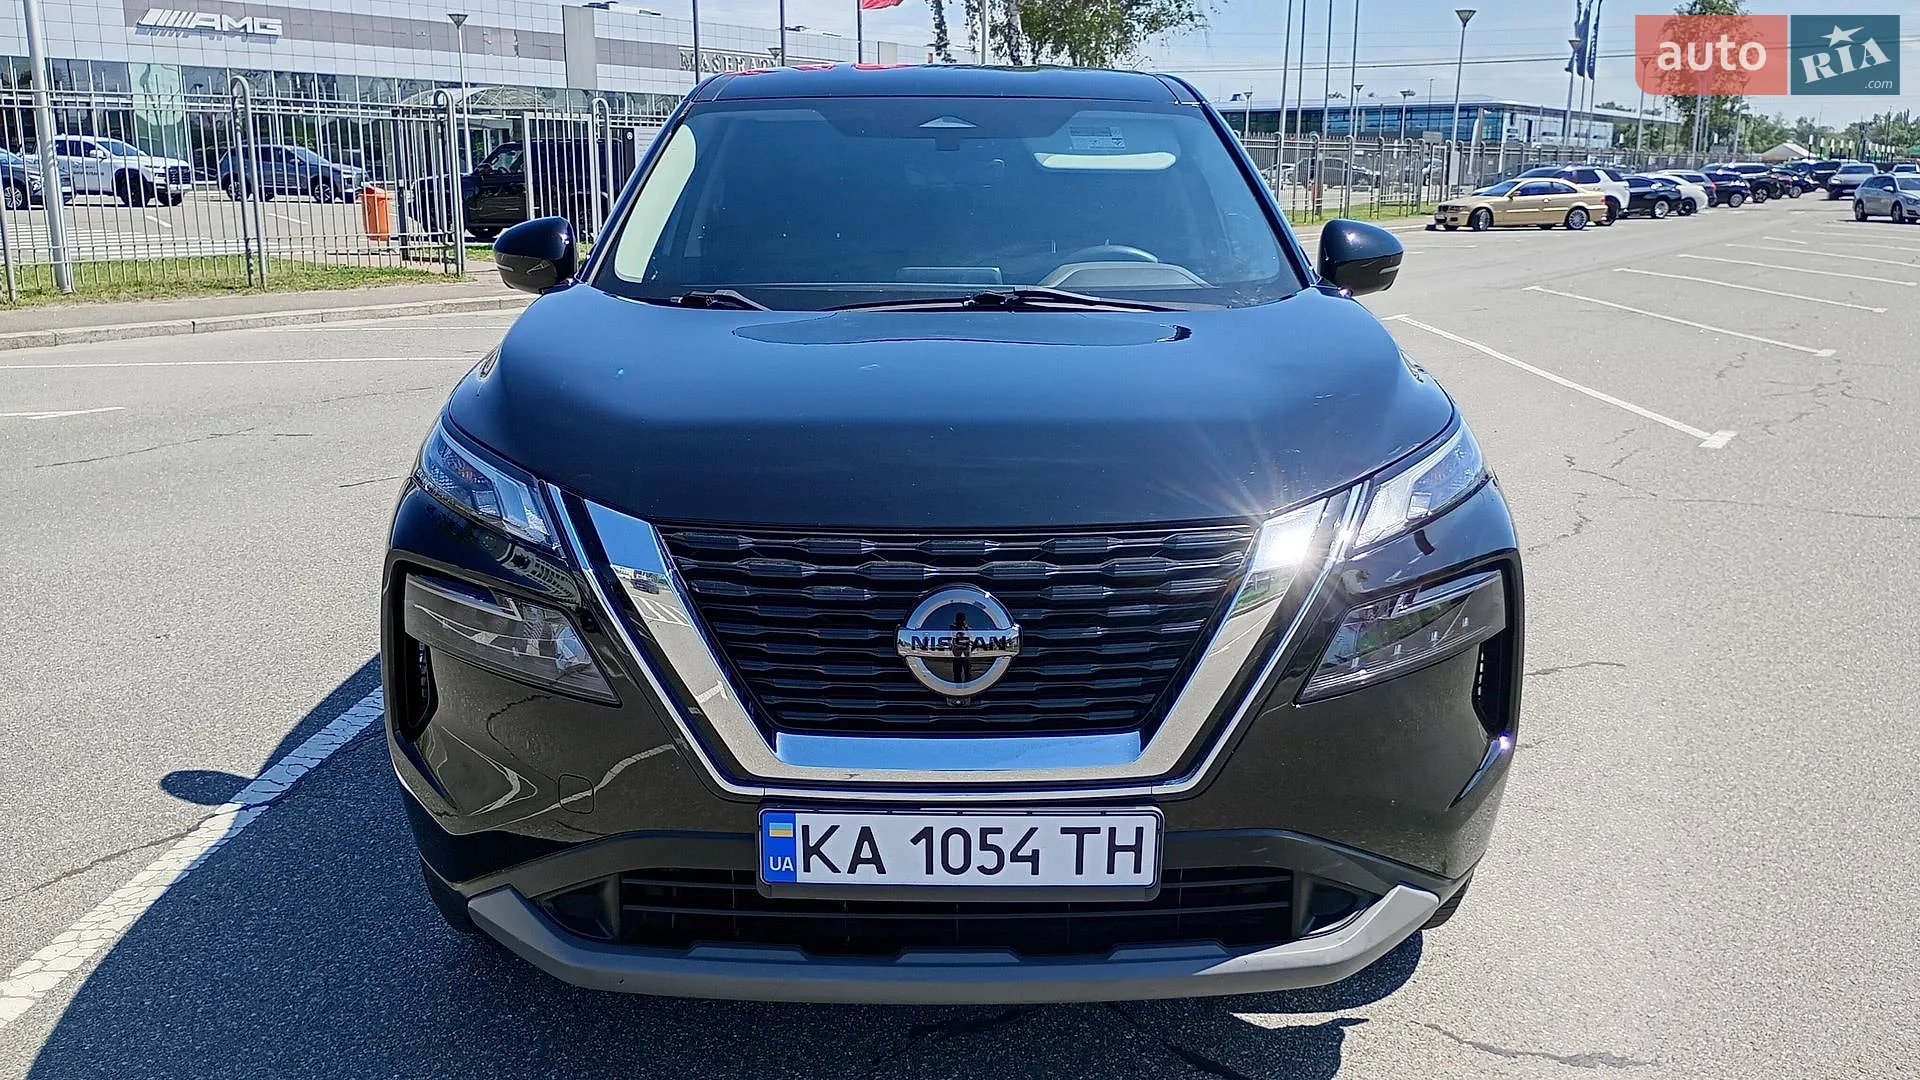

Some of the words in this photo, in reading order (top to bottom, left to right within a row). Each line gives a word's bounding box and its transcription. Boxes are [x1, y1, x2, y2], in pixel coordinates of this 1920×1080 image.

[187, 12, 283, 36] AMG
[910, 635, 1007, 651] NISSAN
[800, 824, 887, 875] KA
[909, 826, 1041, 876] 1054
[1059, 826, 1144, 875] TH
[769, 856, 794, 872] UA
